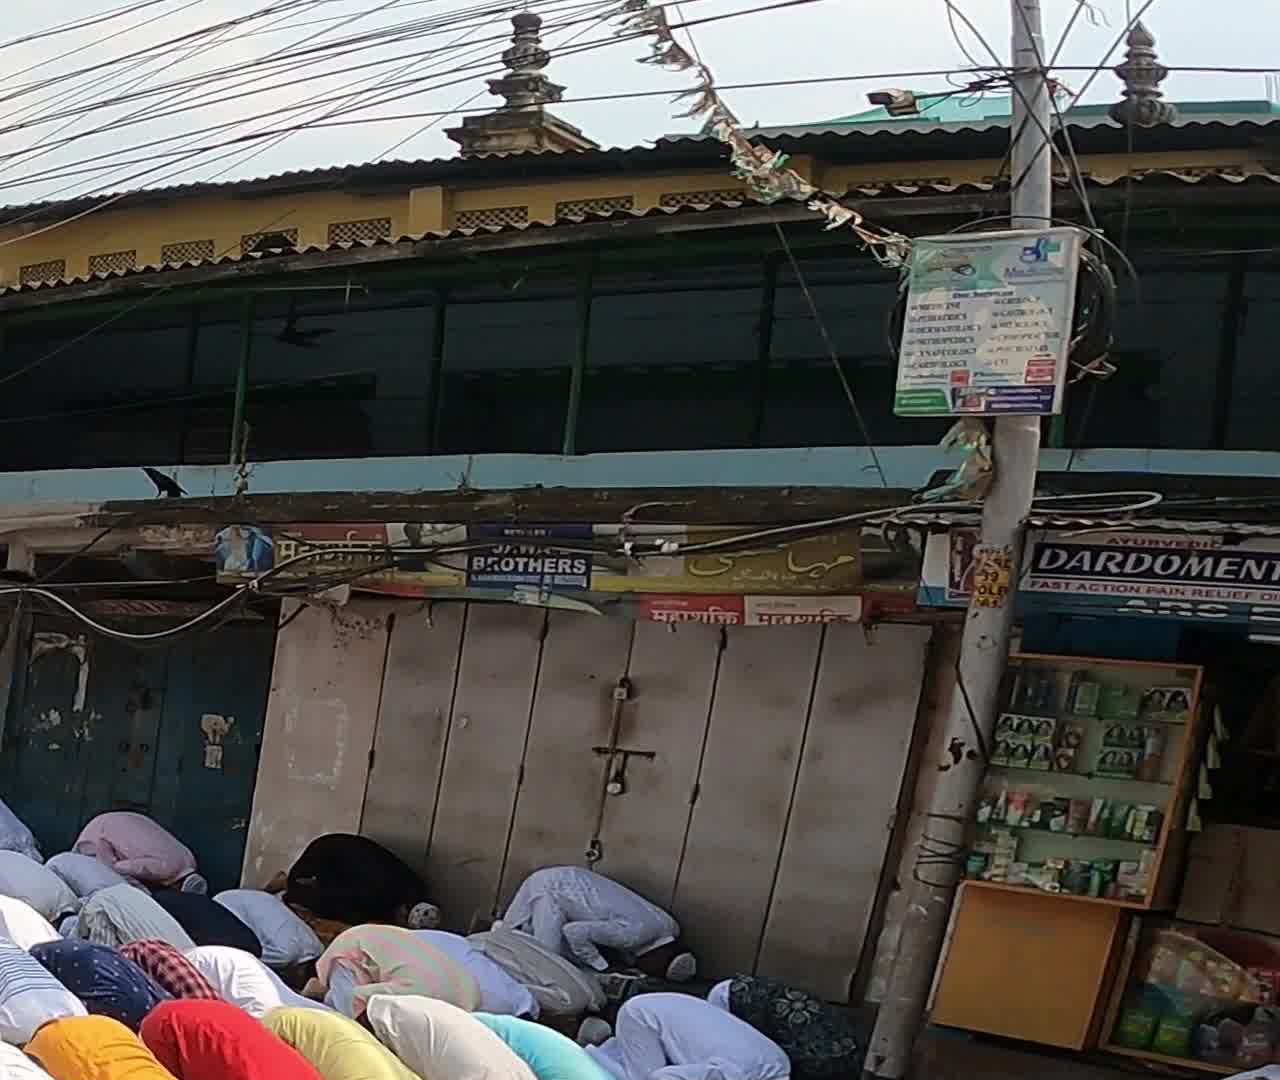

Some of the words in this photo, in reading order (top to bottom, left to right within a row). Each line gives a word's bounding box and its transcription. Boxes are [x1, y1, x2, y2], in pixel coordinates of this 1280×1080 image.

[1106, 536, 1222, 551] AYURVEDIC
[472, 556, 587, 575] BROTHERS
[1029, 579, 1071, 591] FAST
[1075, 582, 1141, 594] ACTION
[1146, 586, 1186, 597] PAIN
[1191, 588, 1252, 600] RELIEF
